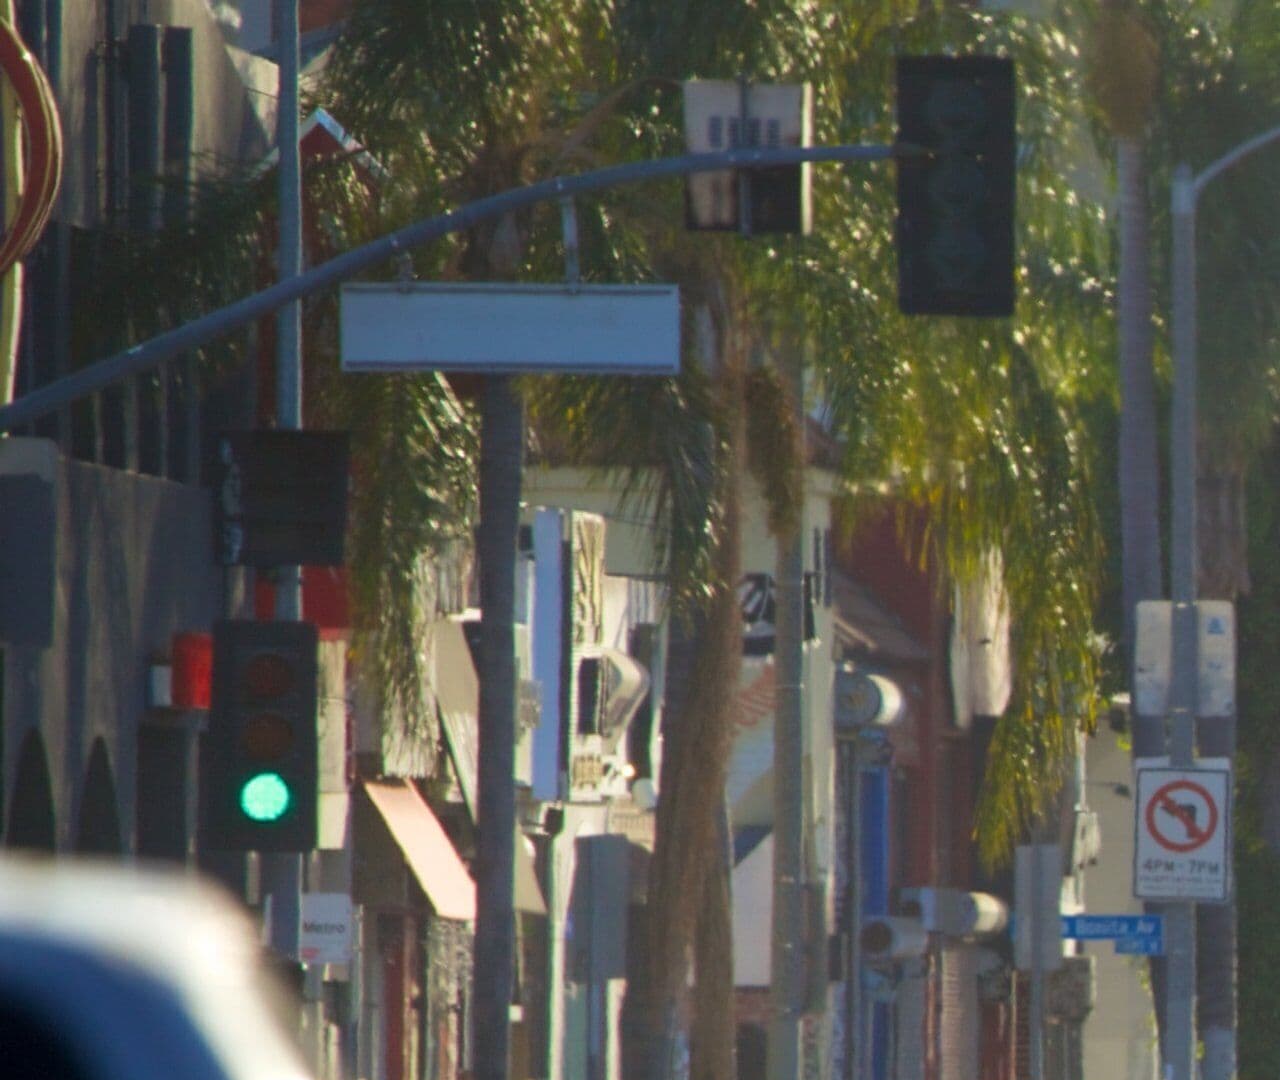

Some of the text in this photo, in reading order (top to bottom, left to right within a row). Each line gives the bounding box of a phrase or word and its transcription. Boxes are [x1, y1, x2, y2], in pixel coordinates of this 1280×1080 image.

[1142, 860, 1219, 874] 4PM 7PM
[303, 921, 345, 935] Metro
